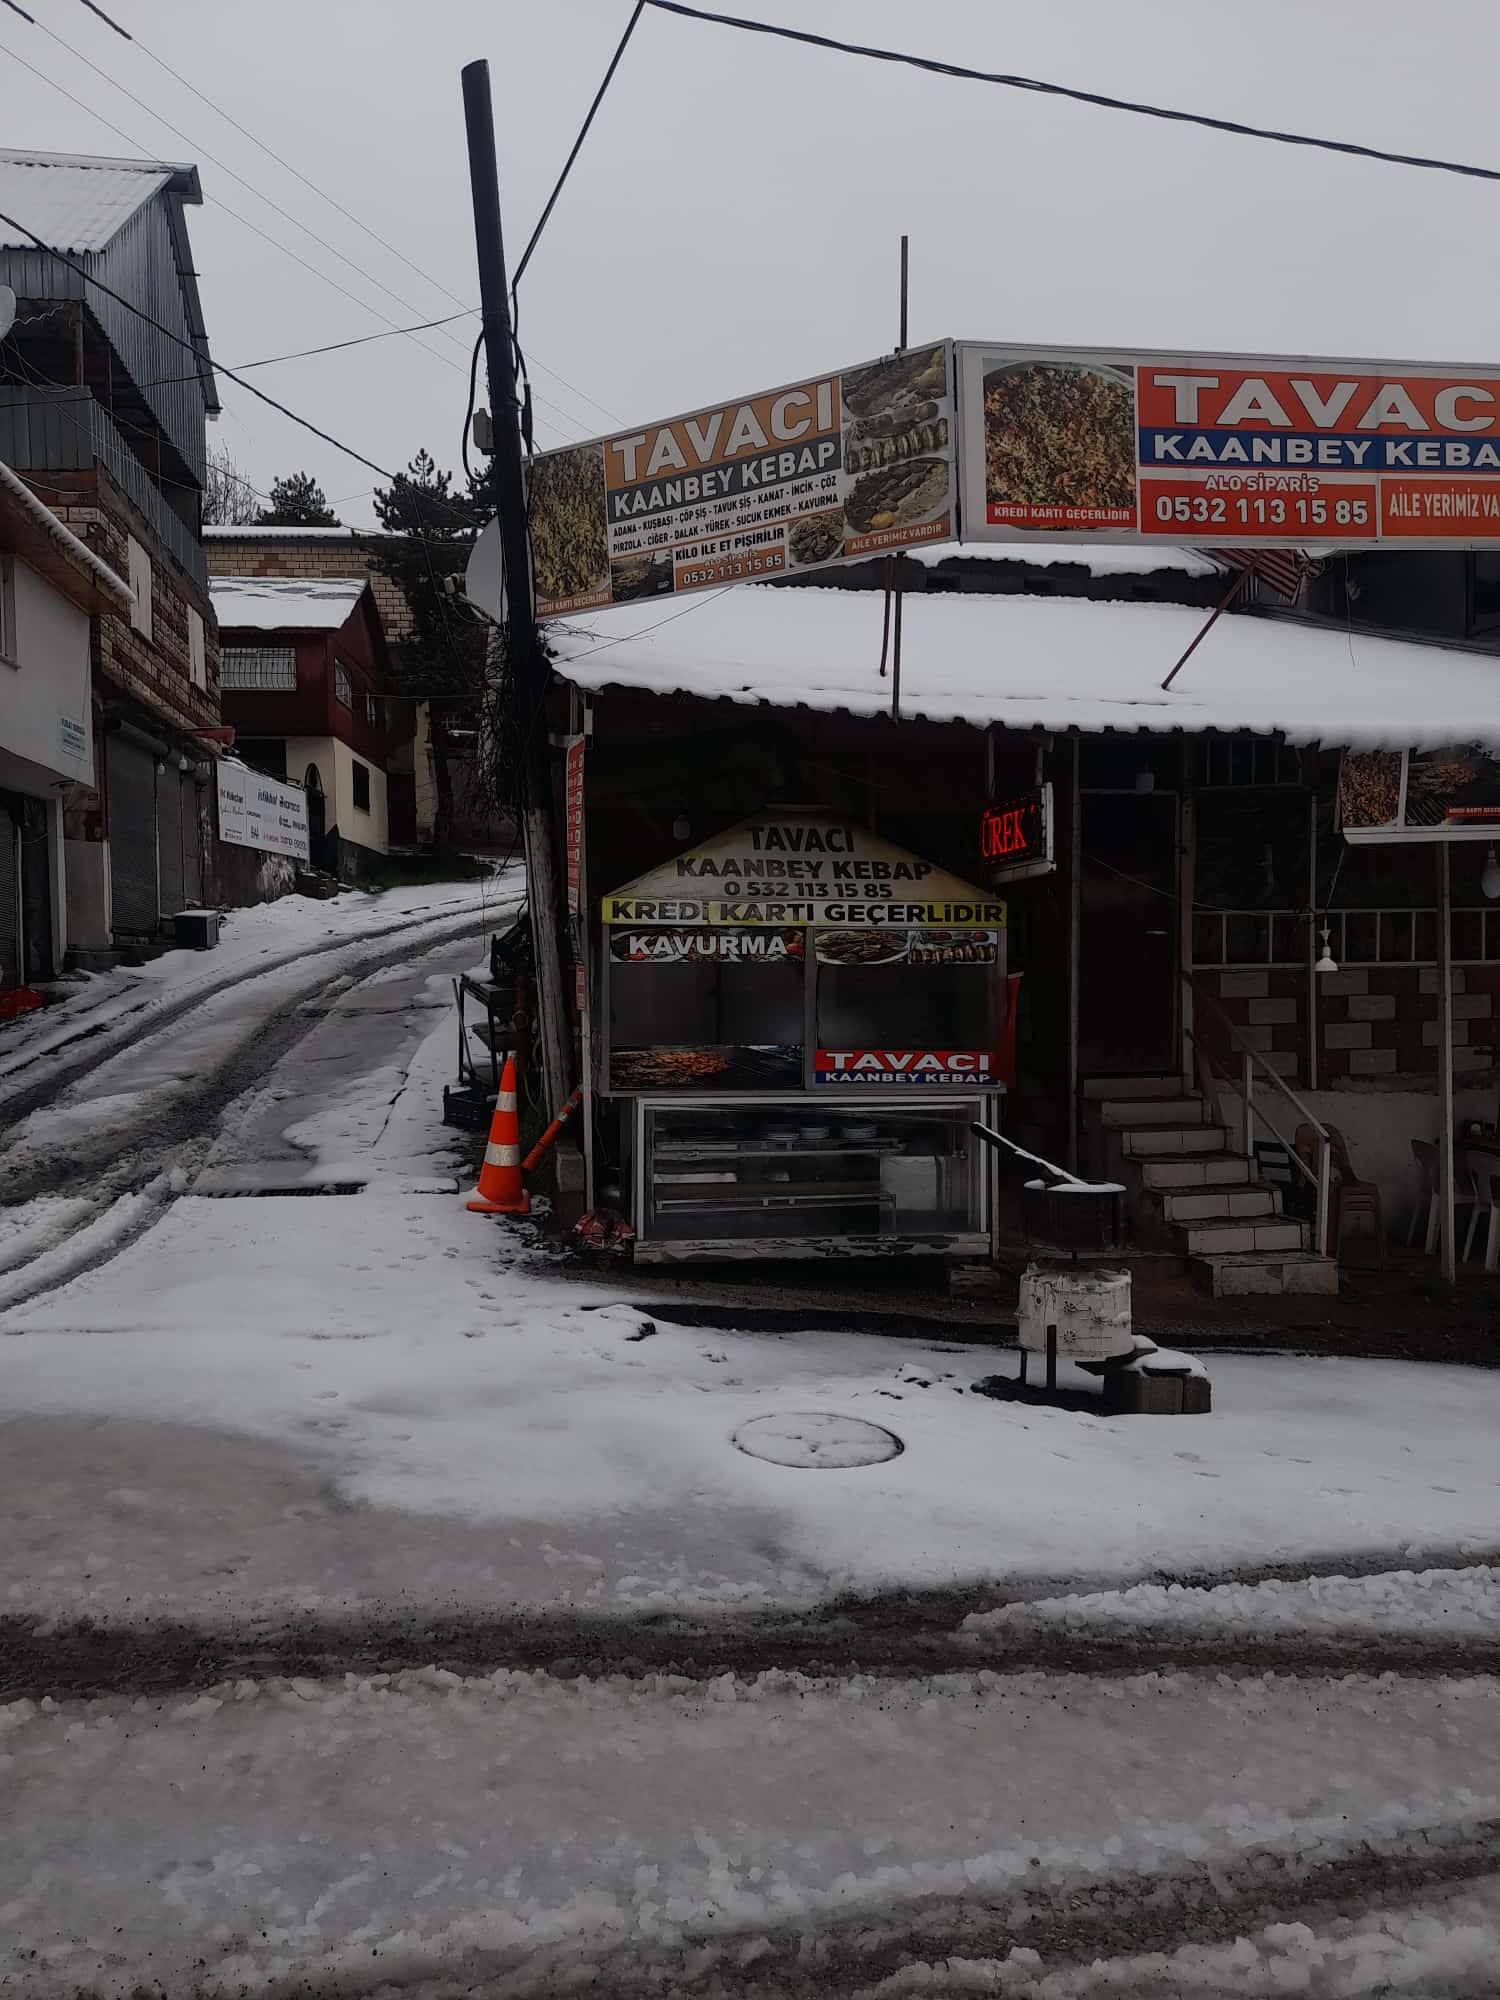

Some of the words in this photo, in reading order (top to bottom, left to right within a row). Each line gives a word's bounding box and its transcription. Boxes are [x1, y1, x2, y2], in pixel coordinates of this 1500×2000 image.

[611, 381, 834, 483] TAVACI
[1153, 433, 1373, 466] KAANBEY
[1384, 441, 1500, 469] KEBA
[613, 467, 734, 518] KAANBEY
[740, 441, 836, 488] KEBAP
[1205, 474, 1242, 492] ALO
[1246, 473, 1321, 495] SİPARİŞ
[613, 524, 638, 537] ADANA
[643, 515, 674, 533] KUŞBAŞI
[713, 500, 738, 514] TAVUK
[738, 496, 752, 511] ŞİŞ
[757, 489, 785, 505] KANAT
[791, 481, 814, 497] İNCİK
[994, 505, 1028, 518] KREDİ
[1030, 507, 1064, 519] KARTI
[1065, 507, 1131, 521] GEÇERLİDİR
[1156, 495, 1228, 523] 0532
[1236, 497, 1287, 524] 113
[1294, 498, 1328, 525] 15
[1334, 499, 1369, 526] 85
[1389, 486, 1421, 518] AİLE
[1423, 487, 1480, 518] YERİMİZ
[674, 526, 700, 541] DALAK
[704, 519, 731, 534] YÜREK
[736, 512, 762, 527] SUCUK
[763, 504, 792, 520] EKMEK
[798, 493, 839, 512] KAVURMA
[675, 545, 698, 561] KİLO
[719, 537, 733, 552] ET
[683, 569, 715, 585] 0532
[718, 563, 742, 578] 113
[746, 559, 763, 572] 15
[765, 554, 783, 568] 85
[751, 825, 855, 853] TAVACI
[676, 858, 824, 879] KAANBEY
[832, 860, 932, 881] KEBAP
[746, 881, 790, 897] 532
[794, 882, 829, 897] 113
[833, 882, 857, 897] 15
[864, 882, 893, 898] 85
[719, 903, 814, 921] KARTI
[628, 935, 789, 955] KAVURMA
[824, 1052, 990, 1072] TAVACI
[825, 1072, 922, 1084] KAANBEY
[924, 1073, 990, 1084] KEBAP
